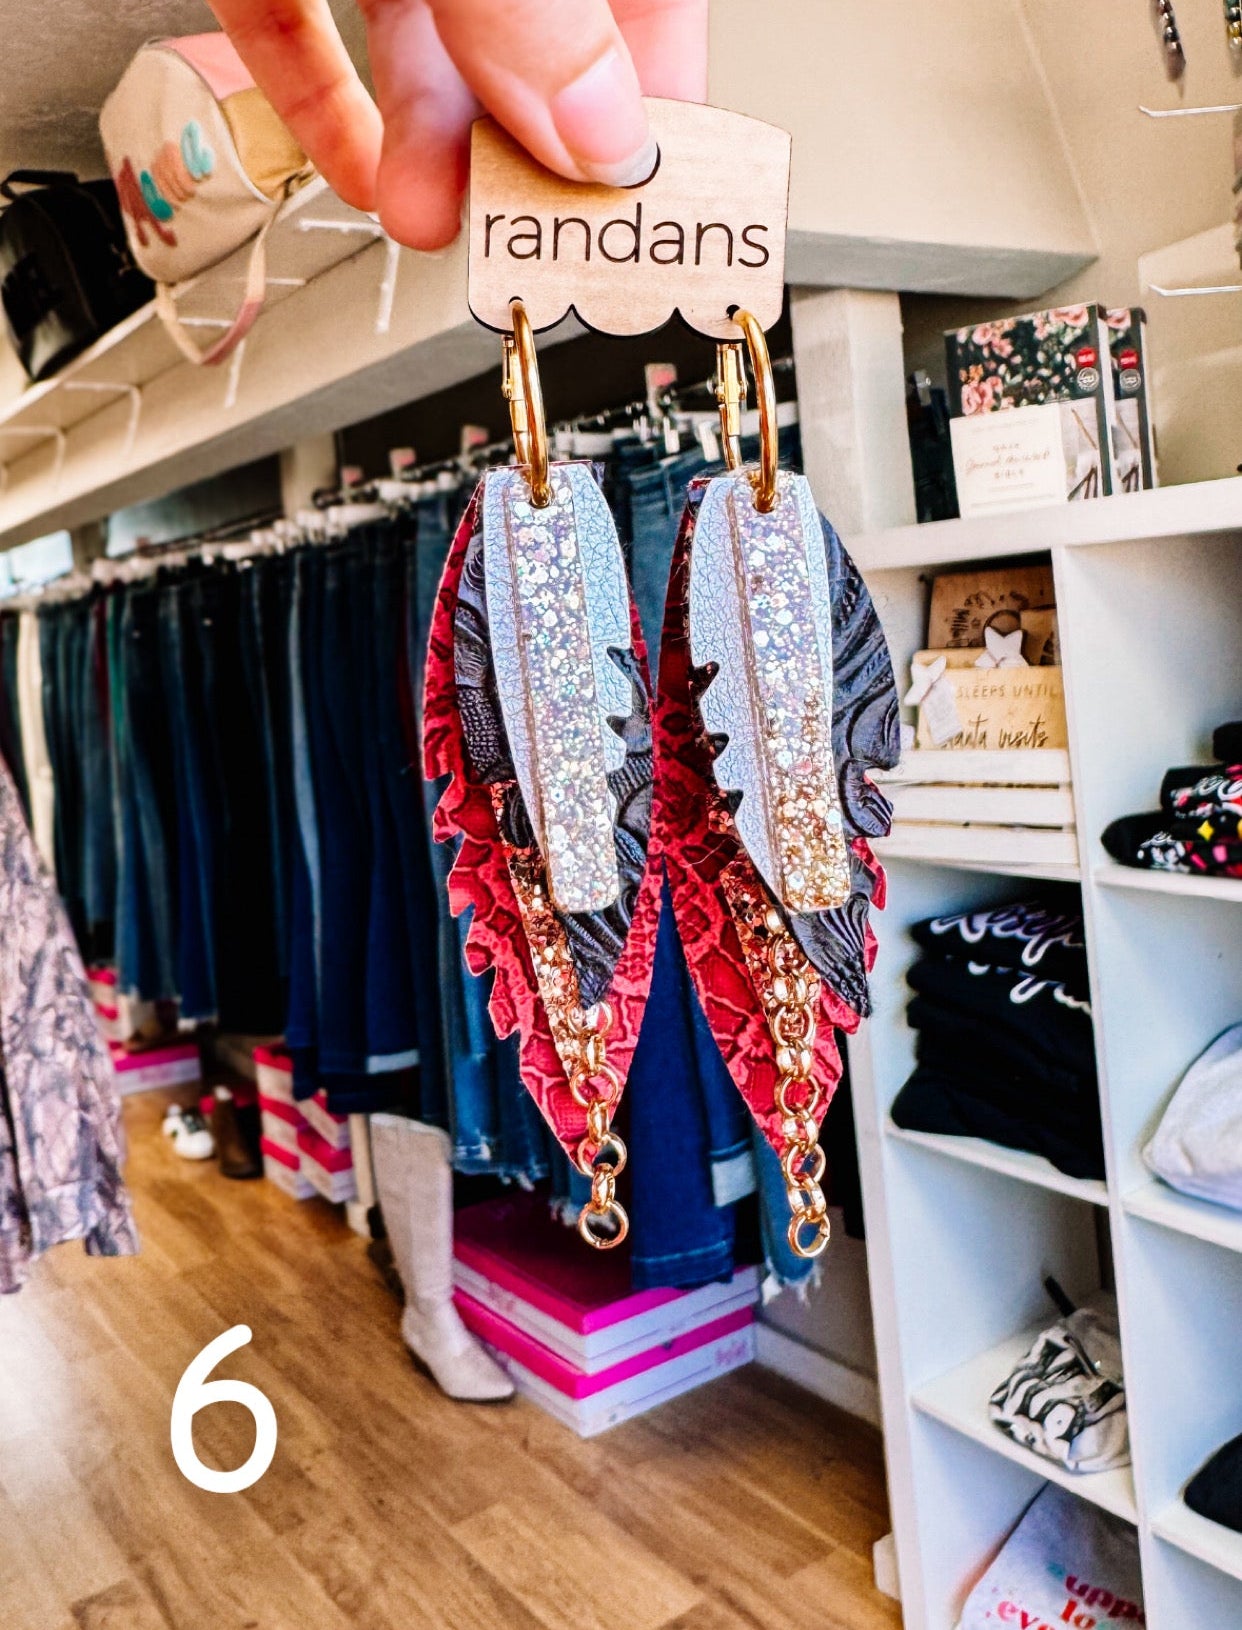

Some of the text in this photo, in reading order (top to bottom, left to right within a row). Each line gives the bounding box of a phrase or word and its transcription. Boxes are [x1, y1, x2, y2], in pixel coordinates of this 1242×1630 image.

[484, 202, 770, 268] randans
[956, 681, 1058, 699] SLEEPS UNTIL
[941, 714, 1048, 748] anta visits
